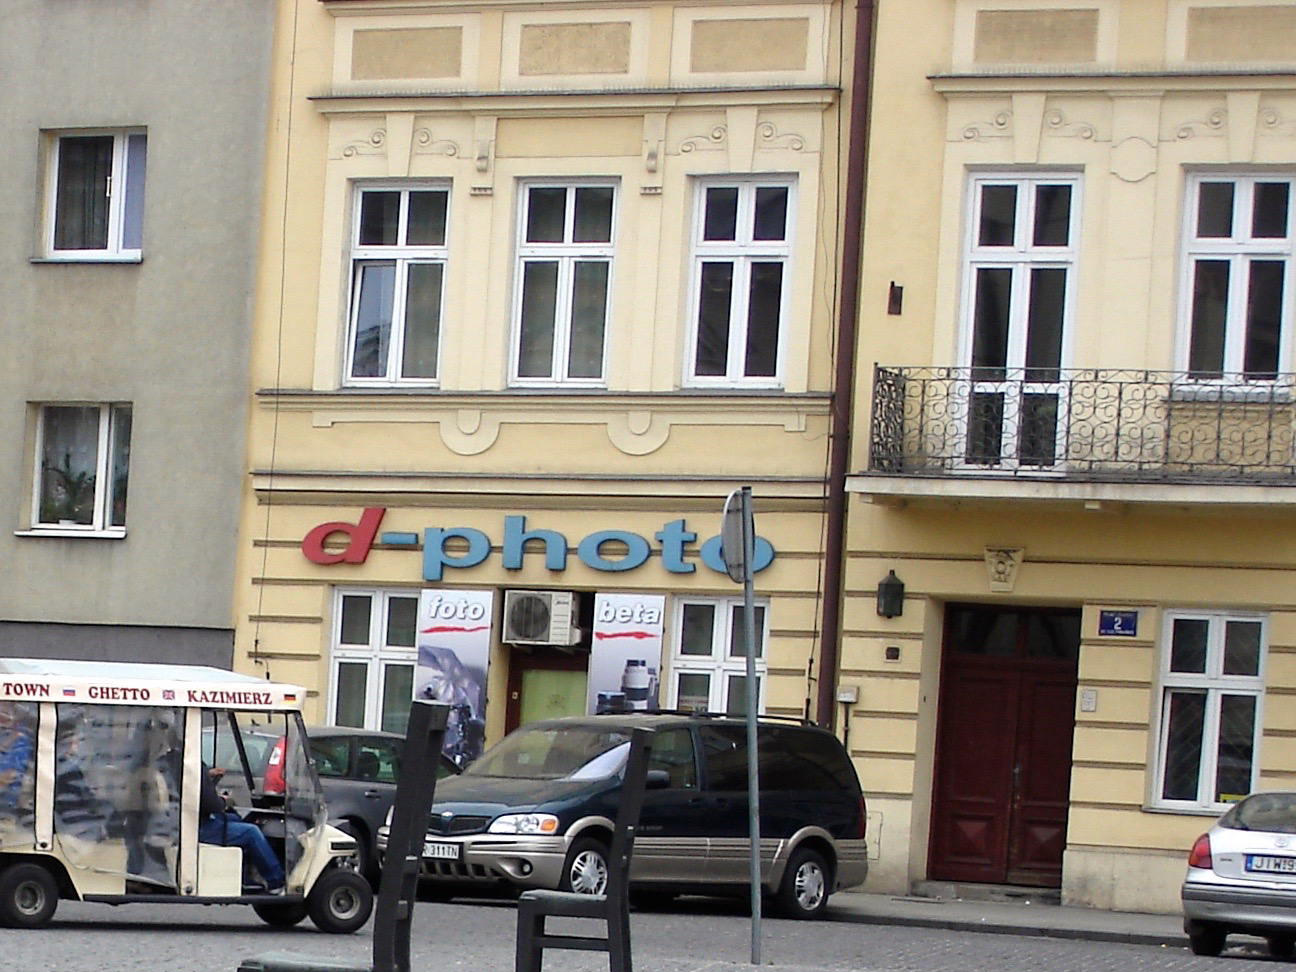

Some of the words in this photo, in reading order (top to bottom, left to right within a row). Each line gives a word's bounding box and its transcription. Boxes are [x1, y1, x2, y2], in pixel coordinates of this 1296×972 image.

[301, 507, 774, 581] d-photo
[429, 595, 485, 620] foto
[598, 600, 661, 625] beta
[1114, 616, 1122, 630] 2
[2, 681, 50, 697] TOWN
[88, 686, 151, 701] GHETTO
[186, 689, 273, 705] KAZIMIERZ
